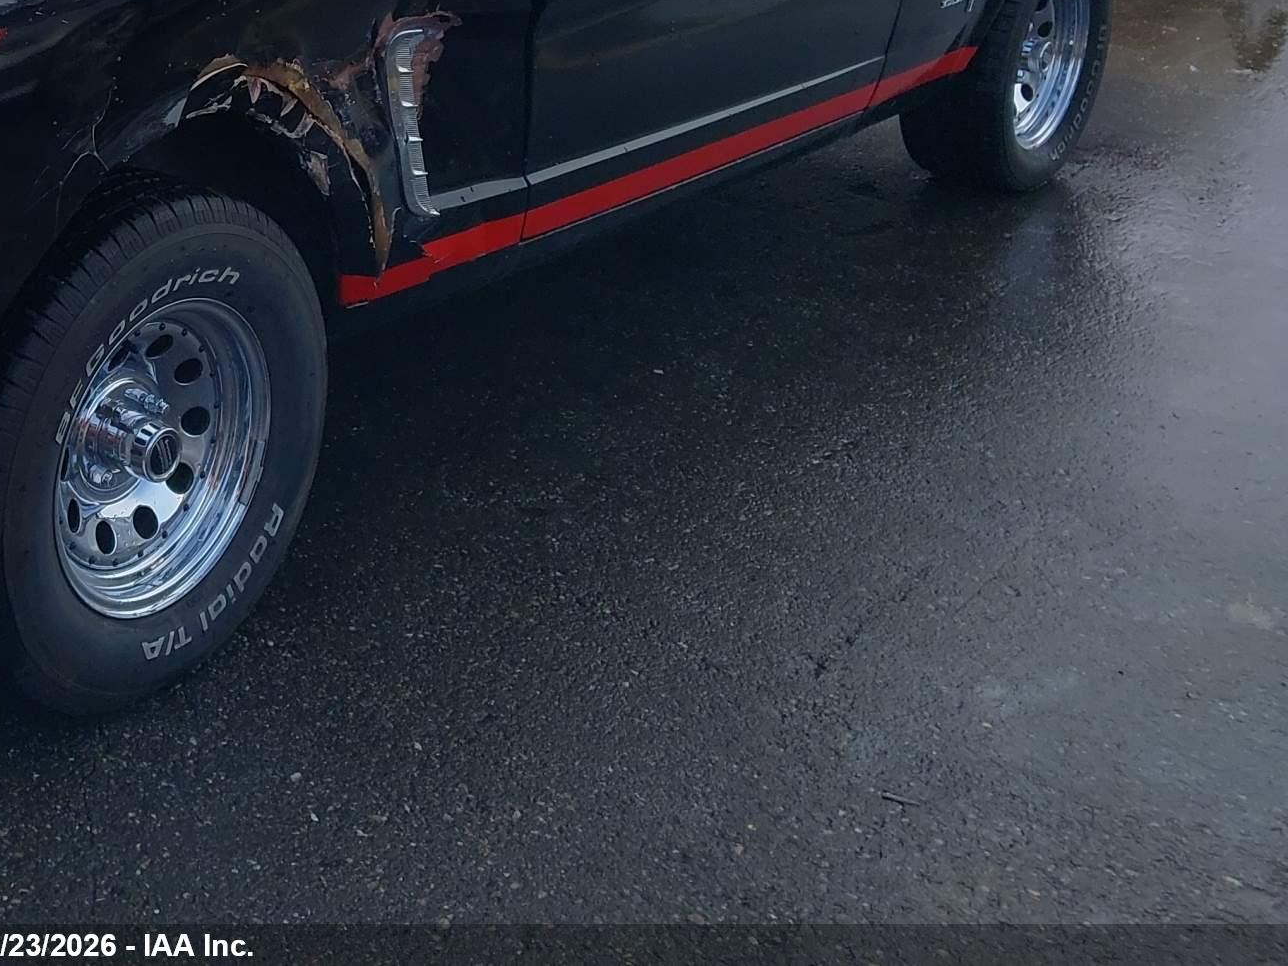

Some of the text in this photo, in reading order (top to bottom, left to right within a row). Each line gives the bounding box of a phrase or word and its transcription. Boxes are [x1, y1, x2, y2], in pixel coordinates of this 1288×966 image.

[55, 266, 241, 445] BFGoodrich
[141, 501, 285, 660] Radial T/A
